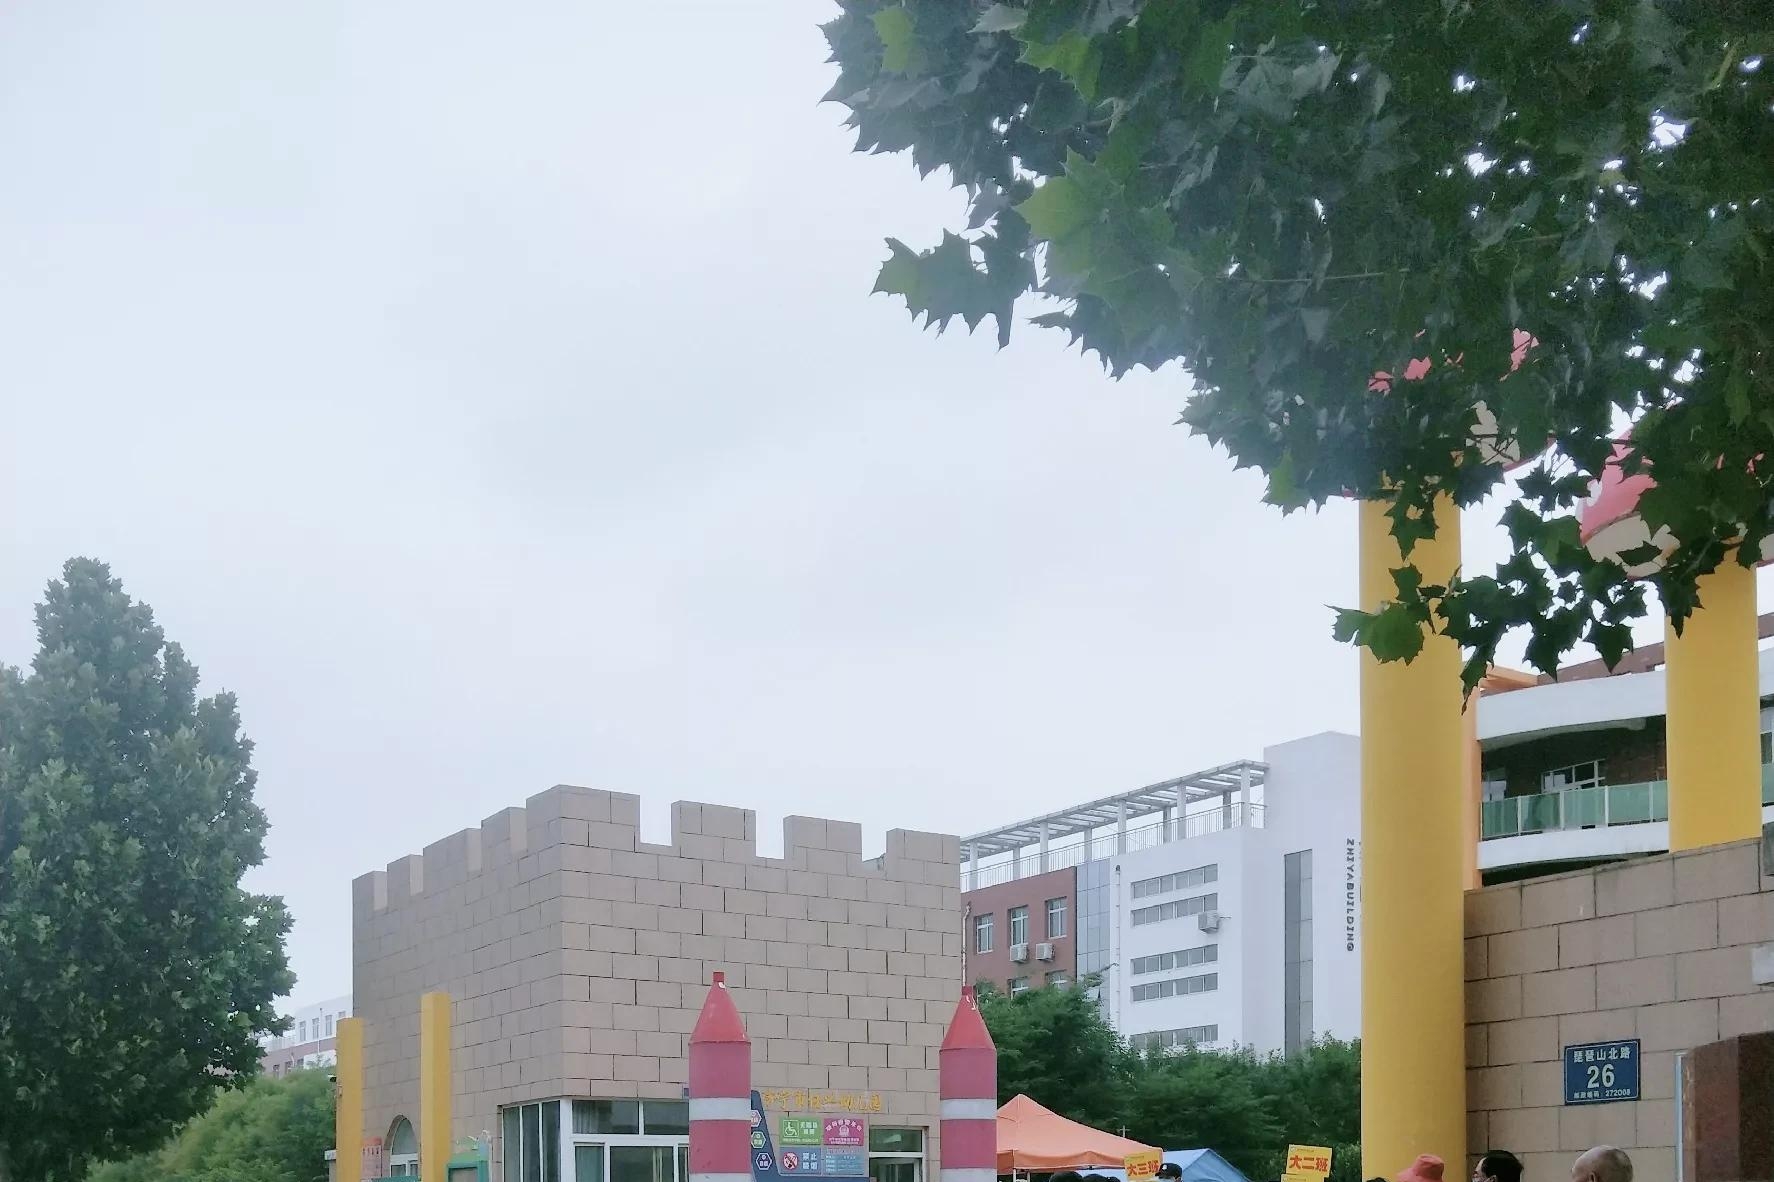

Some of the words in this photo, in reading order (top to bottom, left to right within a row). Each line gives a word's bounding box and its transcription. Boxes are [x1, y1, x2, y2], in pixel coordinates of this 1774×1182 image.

[1574, 1046, 1630, 1063] 琵琶山北路
[1587, 1064, 1614, 1088] 26
[1127, 1160, 1160, 1176] 大三班
[1288, 1154, 1328, 1172] 大二班
